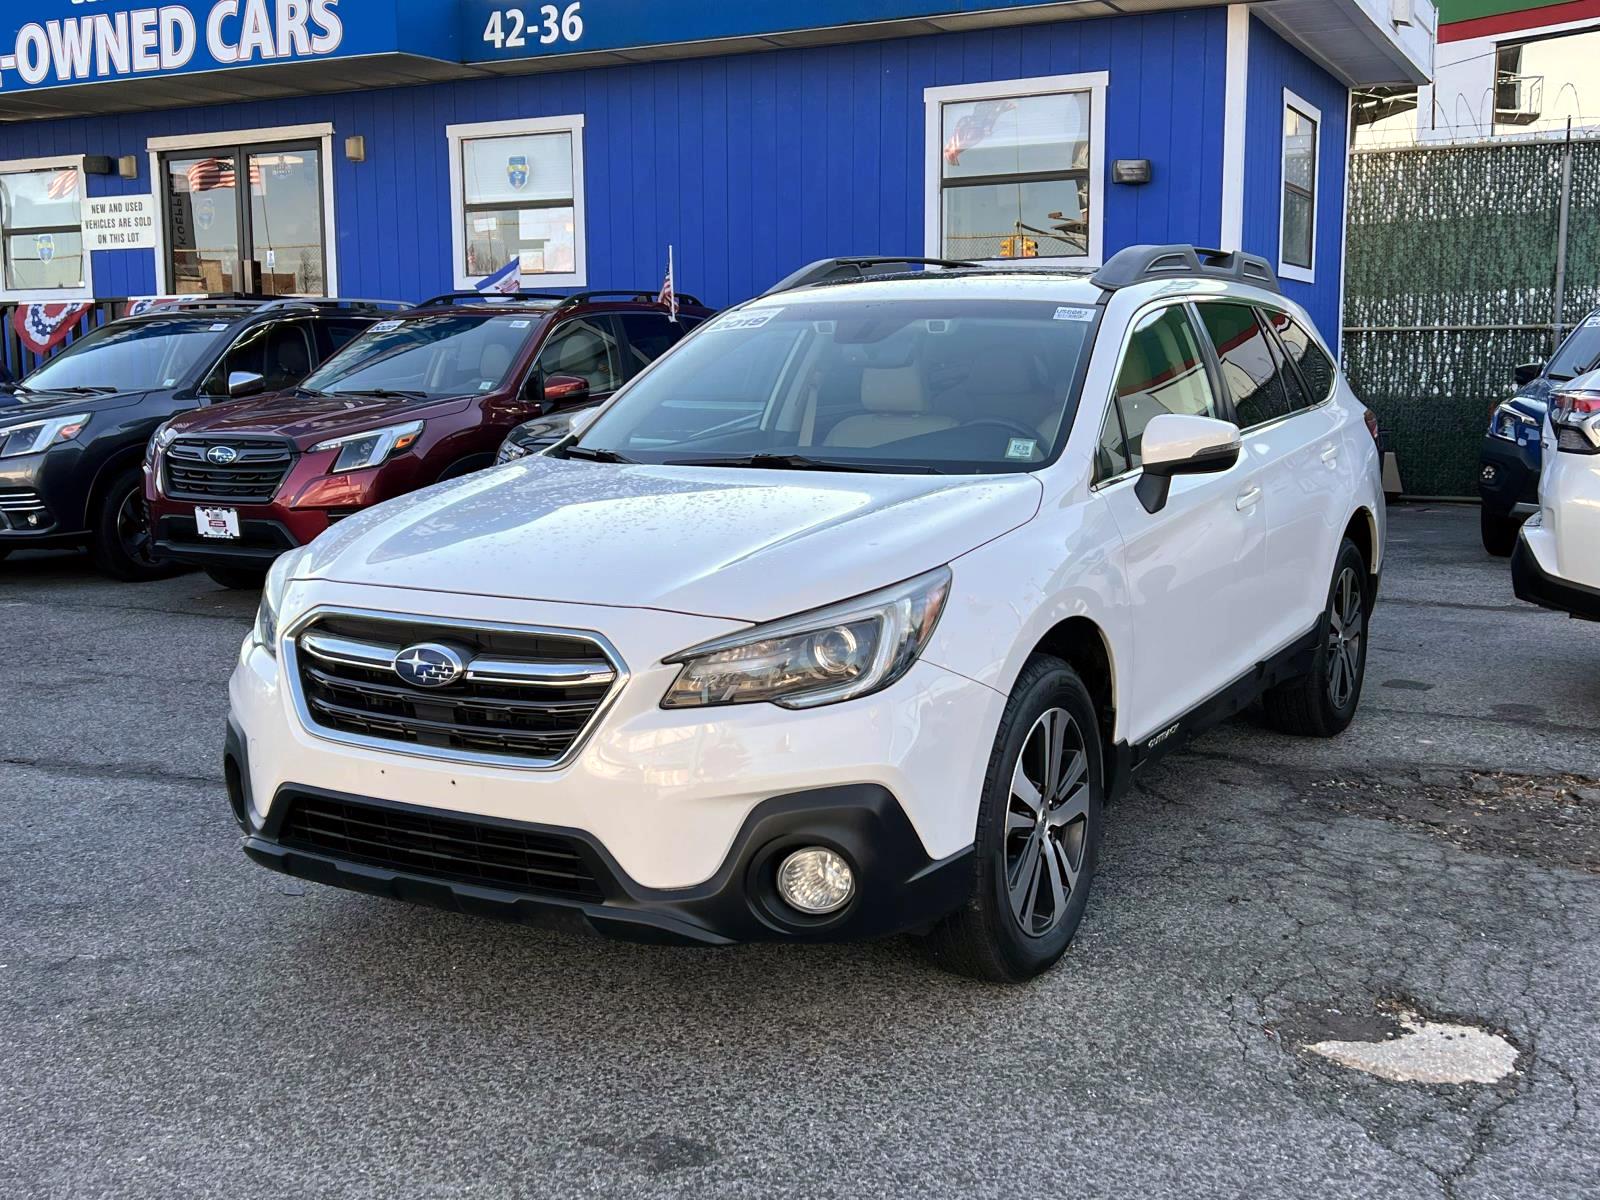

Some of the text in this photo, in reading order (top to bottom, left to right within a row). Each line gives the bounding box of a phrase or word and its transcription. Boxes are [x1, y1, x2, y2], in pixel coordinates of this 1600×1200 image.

[483, 1, 583, 49] 42-36
[0, 0, 343, 88] -OWNED CARS
[91, 201, 143, 214] NEW AND USED
[85, 216, 152, 230] VEHICLES ARE SOLD
[97, 232, 140, 244] ON THIS LOT
